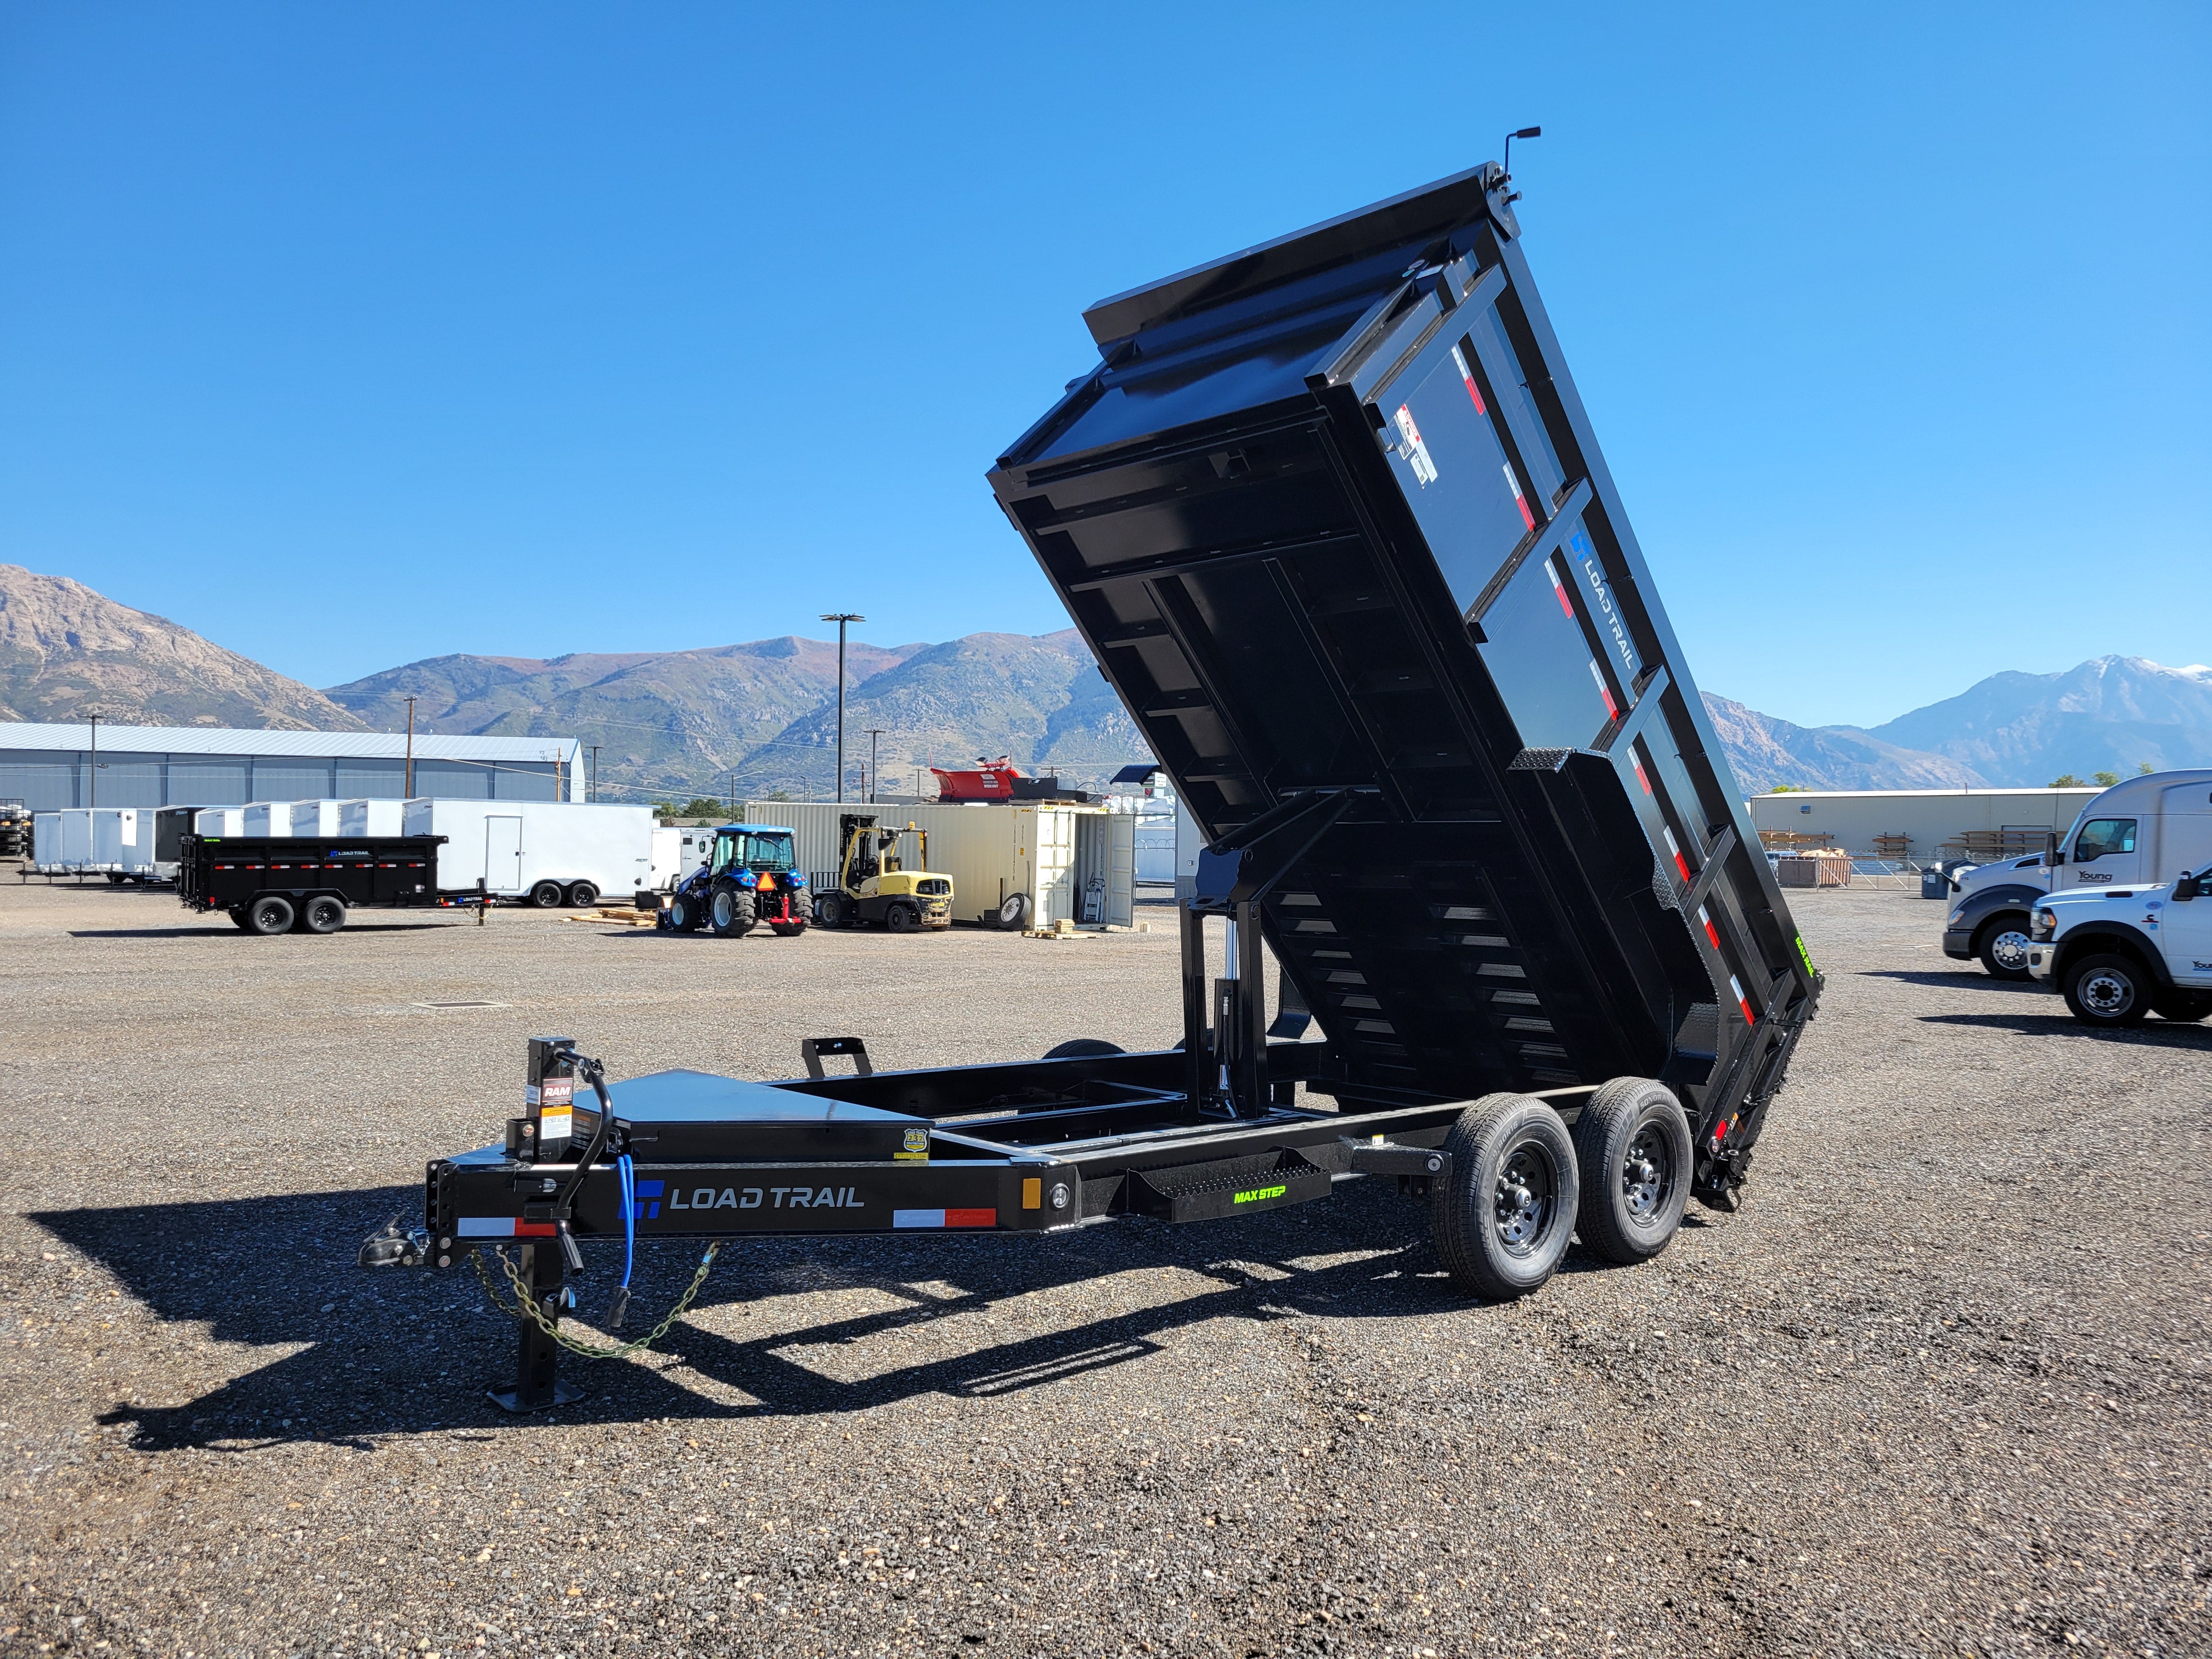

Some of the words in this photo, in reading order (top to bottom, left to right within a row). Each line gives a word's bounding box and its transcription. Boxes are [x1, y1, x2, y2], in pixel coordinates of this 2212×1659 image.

[1406, 414, 1418, 437] DANGER
[1584, 559, 1611, 613] LOAD
[1609, 612, 1633, 670] TRAIL
[2078, 870, 2113, 883] Young
[1795, 936, 1807, 958] MAX
[1804, 956, 1814, 978] RAIL
[544, 1086, 571, 1097] RAM
[670, 1188, 764, 1209] LOAD
[770, 1187, 865, 1208] TRAIL
[1234, 1190, 1259, 1204] MAX
[1259, 1186, 1286, 1200] STEP
